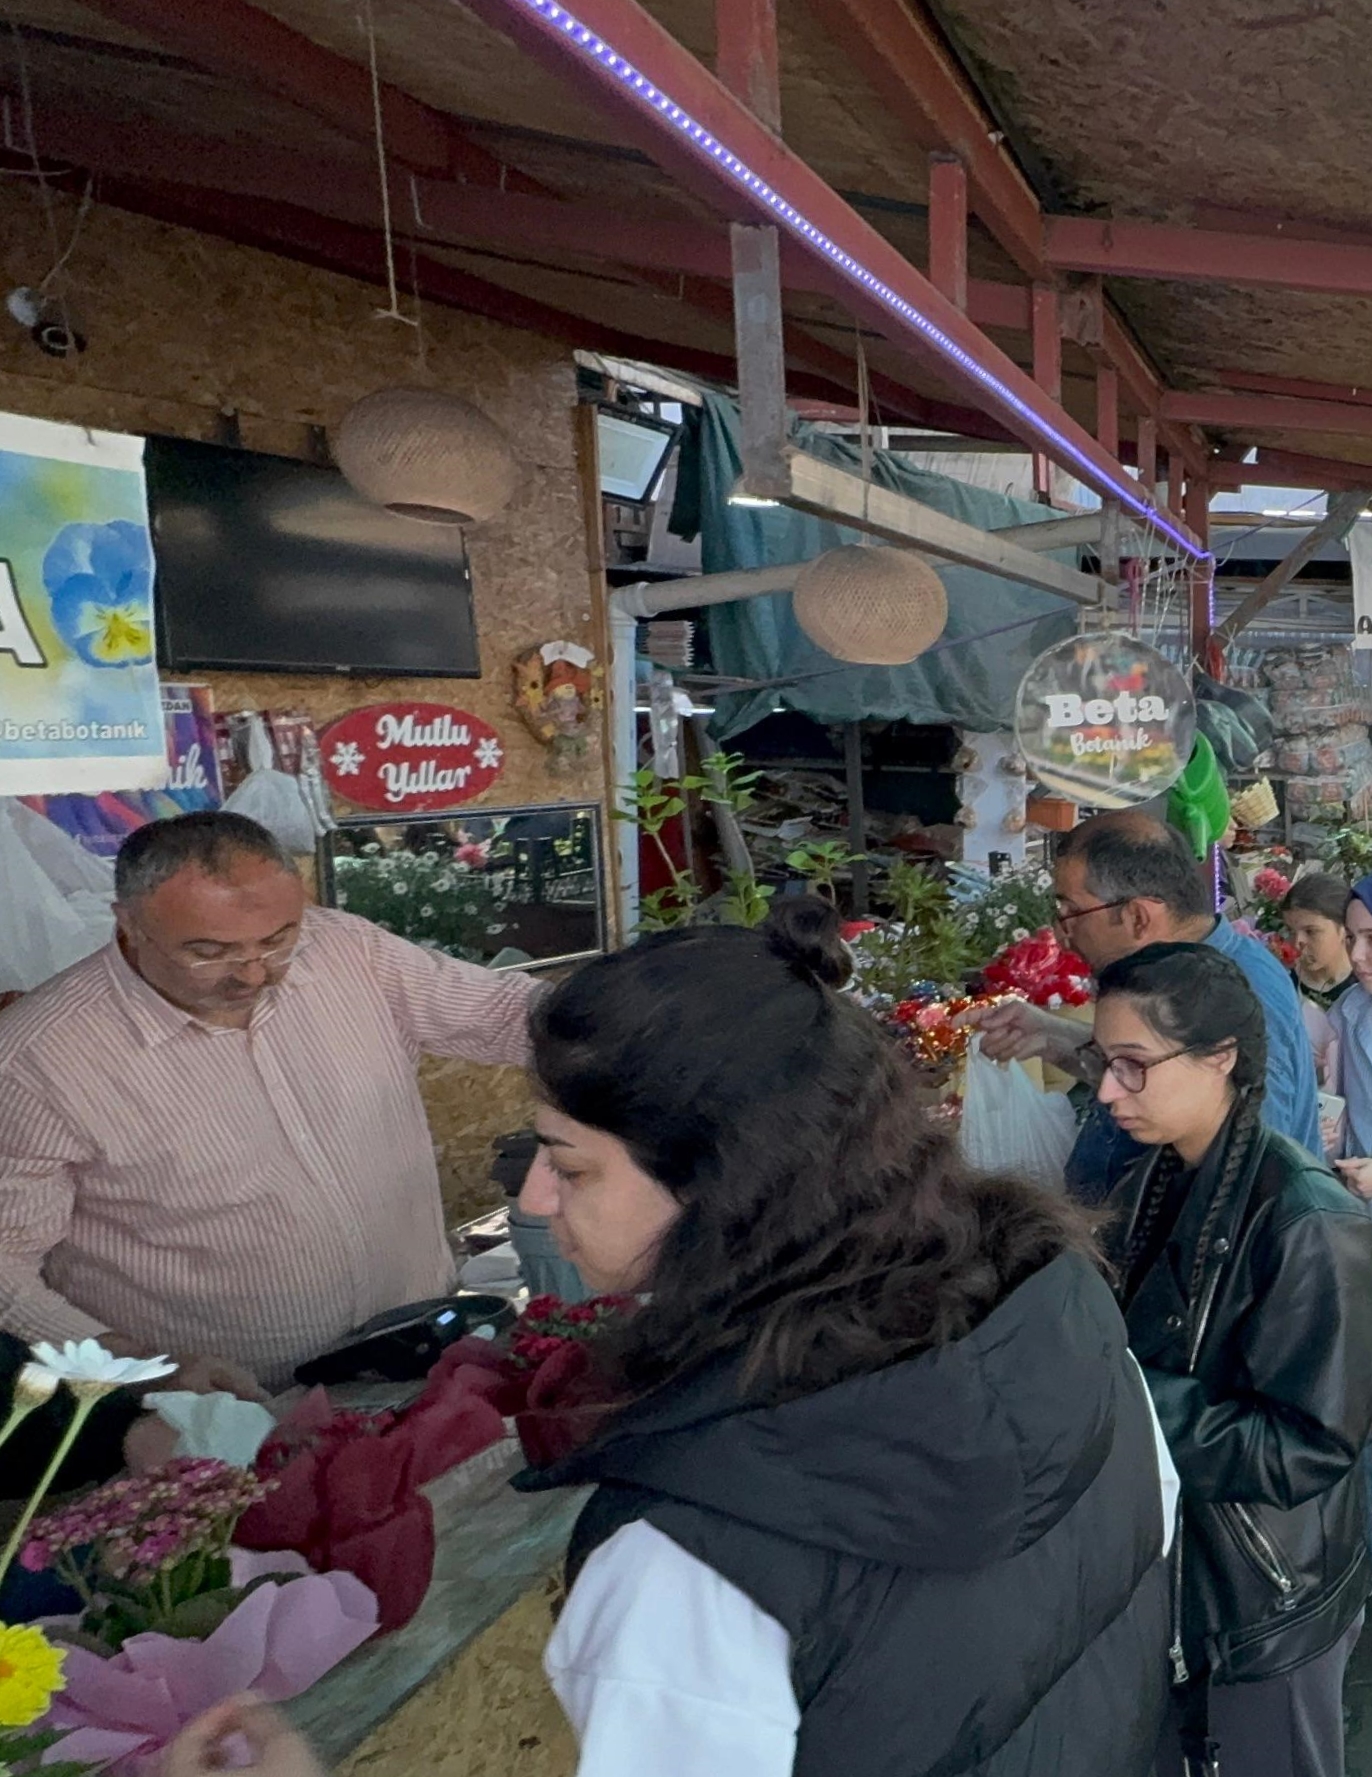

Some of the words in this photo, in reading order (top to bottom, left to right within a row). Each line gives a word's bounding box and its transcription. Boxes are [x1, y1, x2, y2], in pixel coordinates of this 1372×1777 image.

[1045, 691, 1169, 727] Beta
[375, 714, 471, 749] Mutlu
[1070, 727, 1153, 756] Botanik
[377, 760, 472, 802] Yıllar
